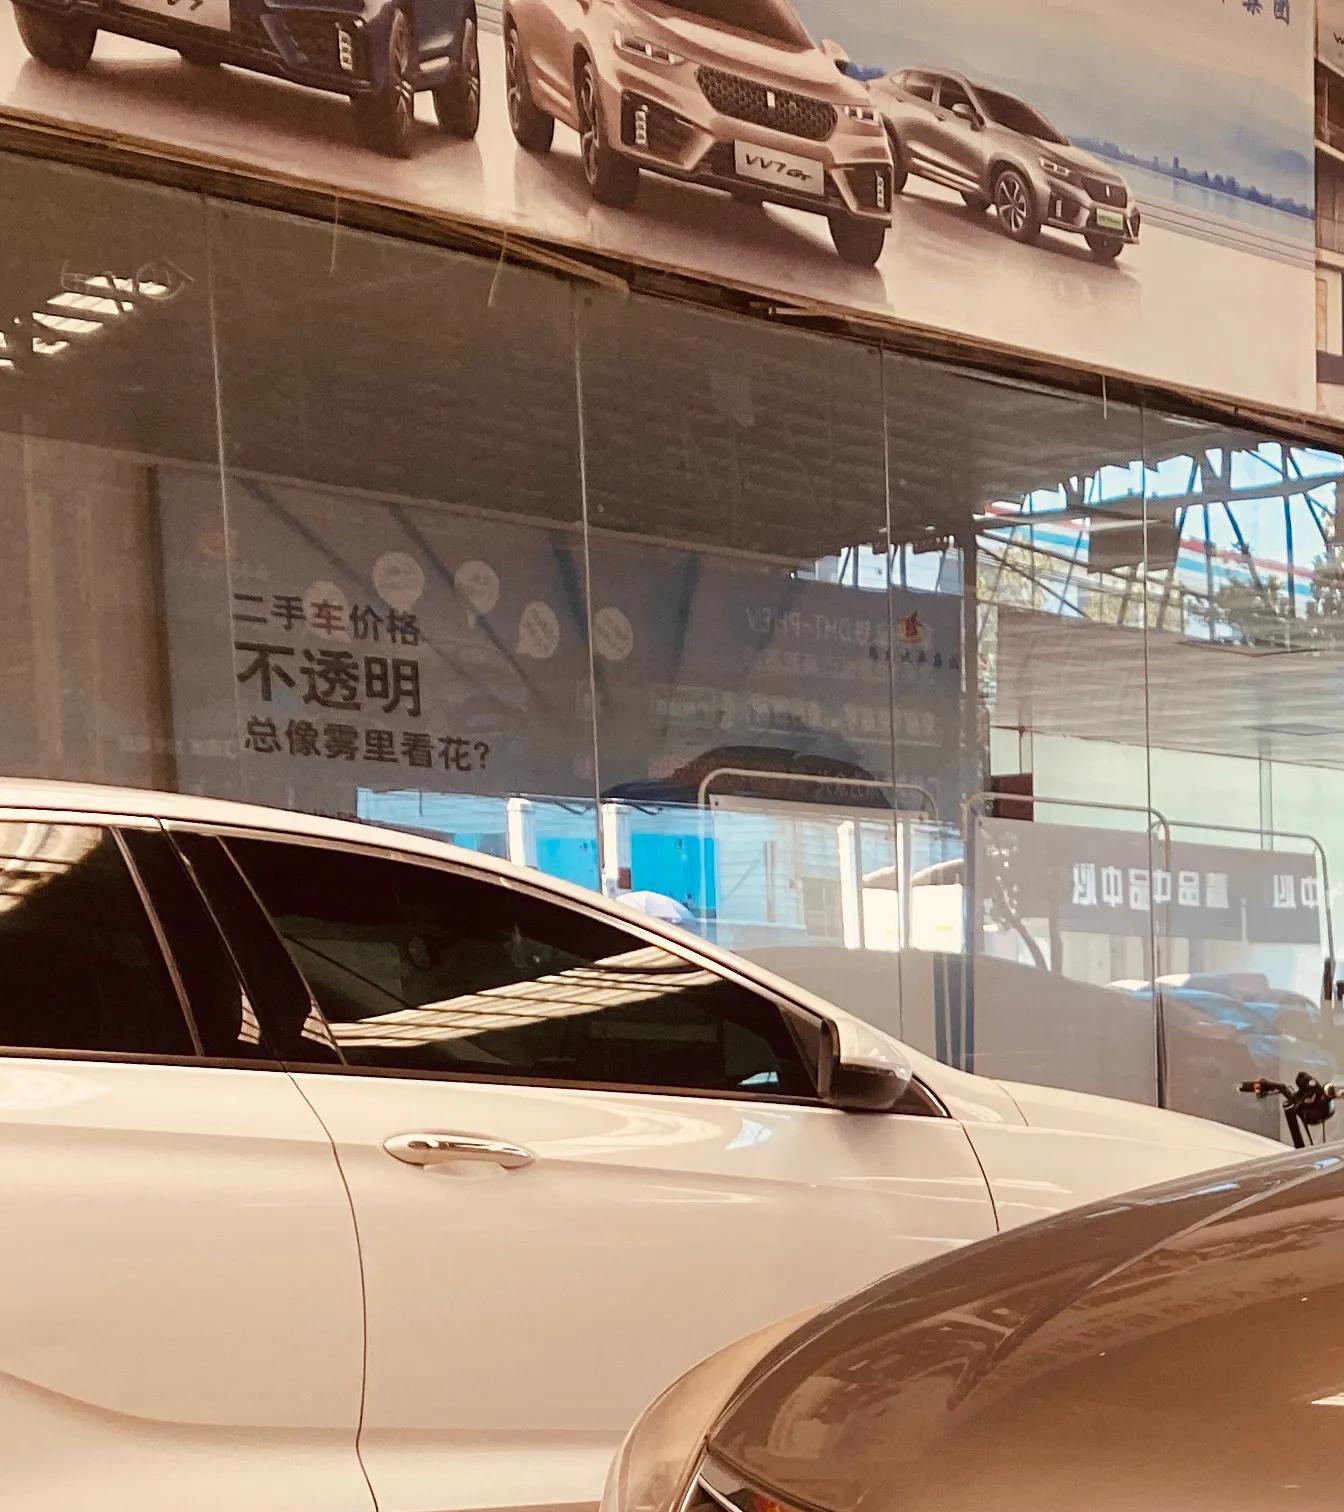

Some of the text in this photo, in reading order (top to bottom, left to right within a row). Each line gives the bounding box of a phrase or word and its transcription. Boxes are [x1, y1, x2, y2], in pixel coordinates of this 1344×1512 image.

[745, 153, 787, 173] VV7
[231, 591, 421, 647] 二手车价格
[234, 641, 422, 717] 不透明
[243, 715, 490, 772] 总像雾里看花?
